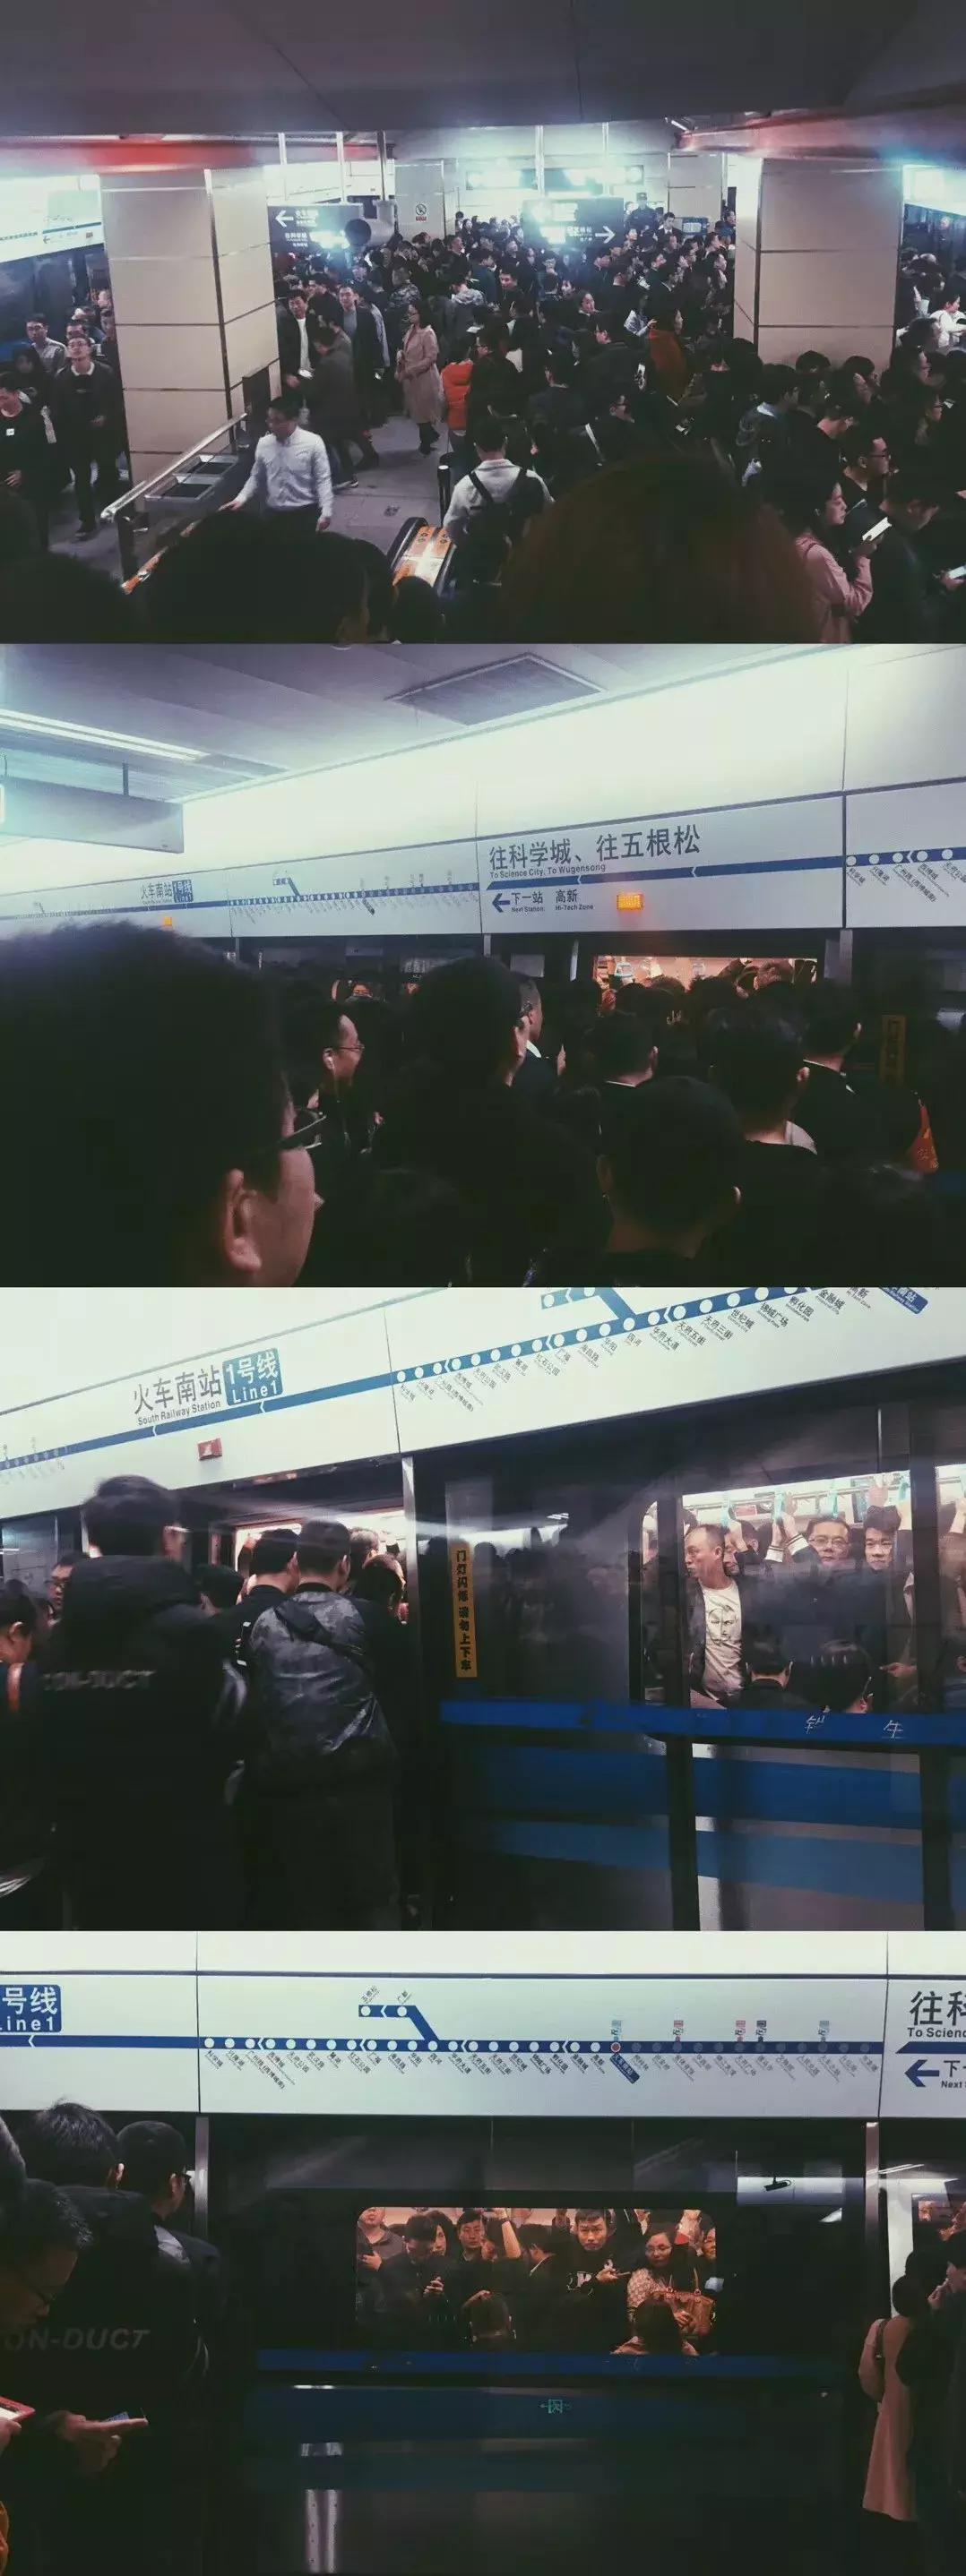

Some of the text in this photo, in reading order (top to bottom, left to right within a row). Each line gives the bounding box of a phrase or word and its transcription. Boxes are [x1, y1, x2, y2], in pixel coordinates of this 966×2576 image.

[489, 824, 700, 871] 往科学城、往五根松
[500, 869, 527, 879] Science
[548, 866, 557, 874] To
[512, 889, 578, 905] 下一站 高新
[578, 903, 594, 911] Zone
[226, 1351, 279, 1386] 1号线
[134, 1365, 222, 1414] 火车南站
[138, 1400, 221, 1426] South Railway Station
[0, 2016, 54, 2031] ine1
[907, 2027, 923, 2038] To
[944, 2060, 966, 2077] 下
[941, 2081, 962, 2089] Next
